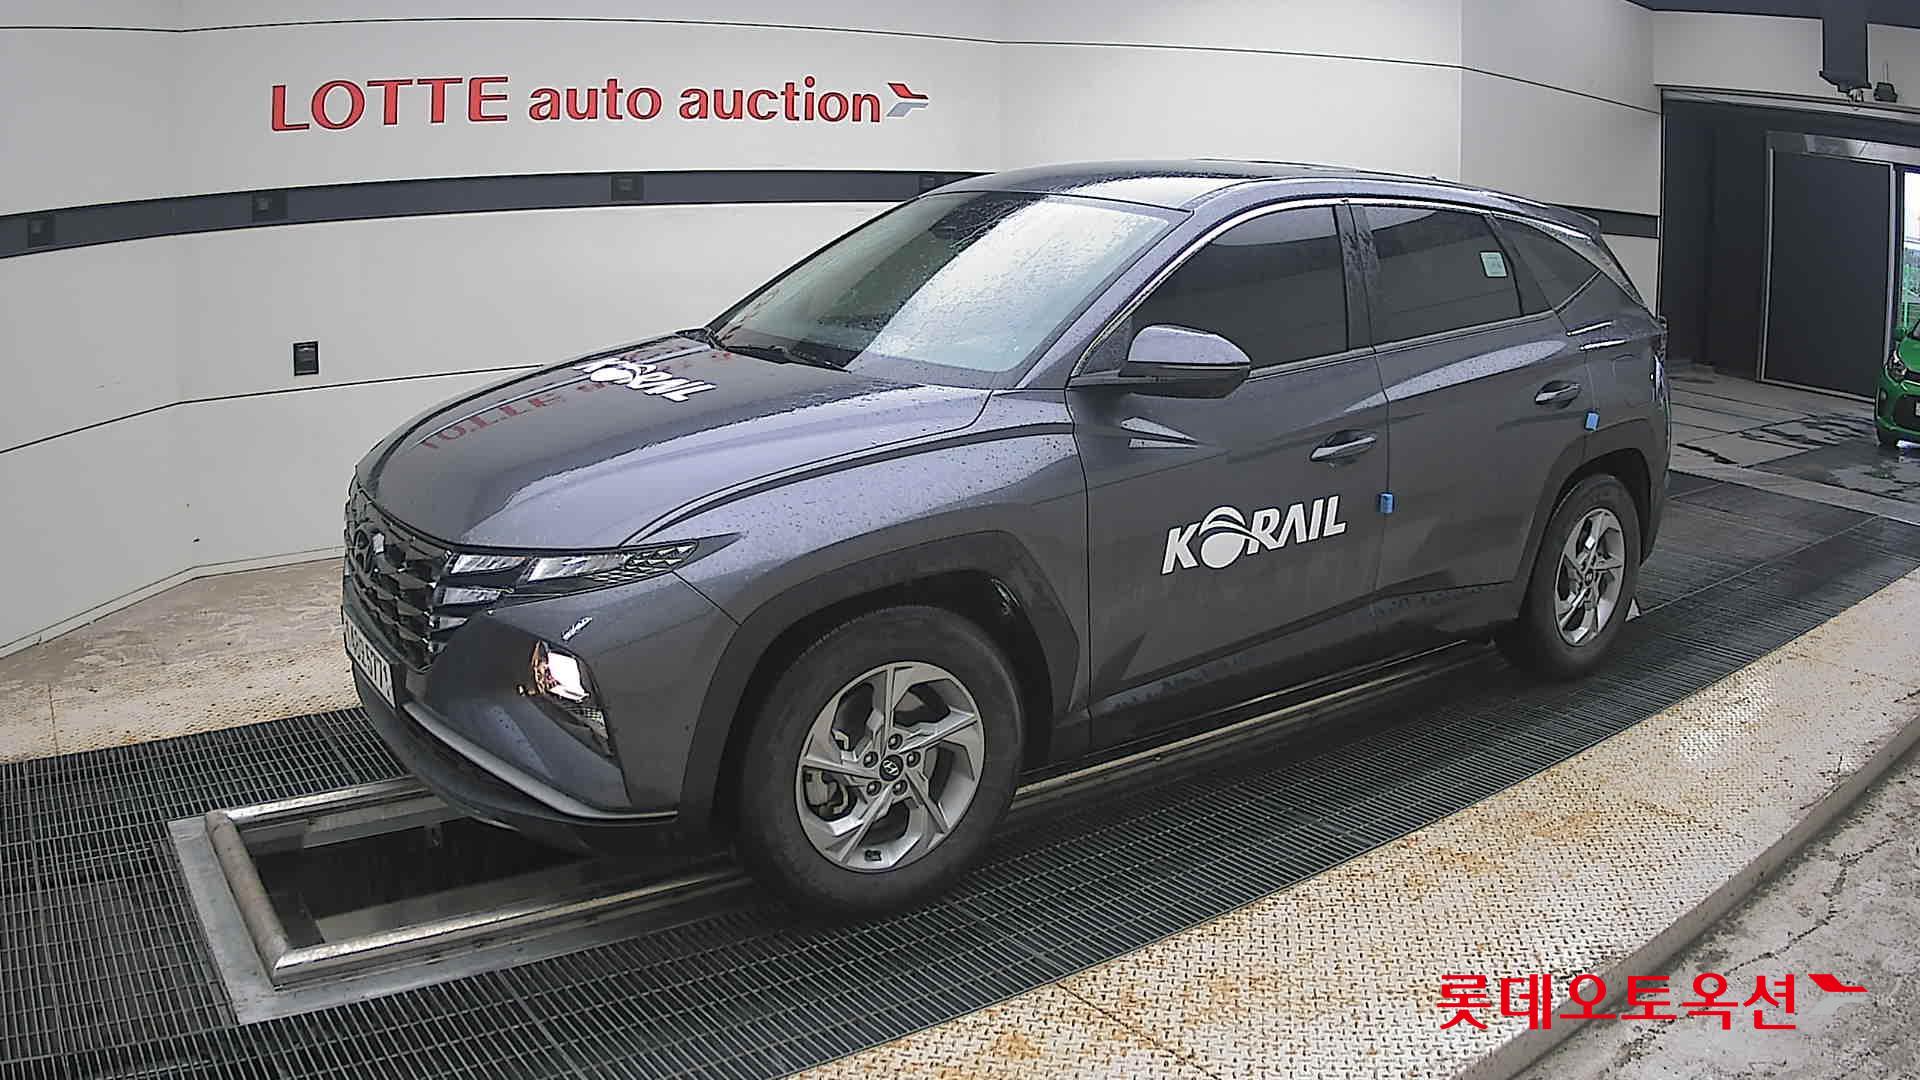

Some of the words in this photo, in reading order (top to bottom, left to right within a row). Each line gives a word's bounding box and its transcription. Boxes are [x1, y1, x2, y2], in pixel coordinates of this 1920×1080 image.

[272, 77, 509, 131] LOTTE
[529, 78, 662, 121] auto
[680, 76, 882, 123] auction
[1161, 495, 1346, 575] KORAIL
